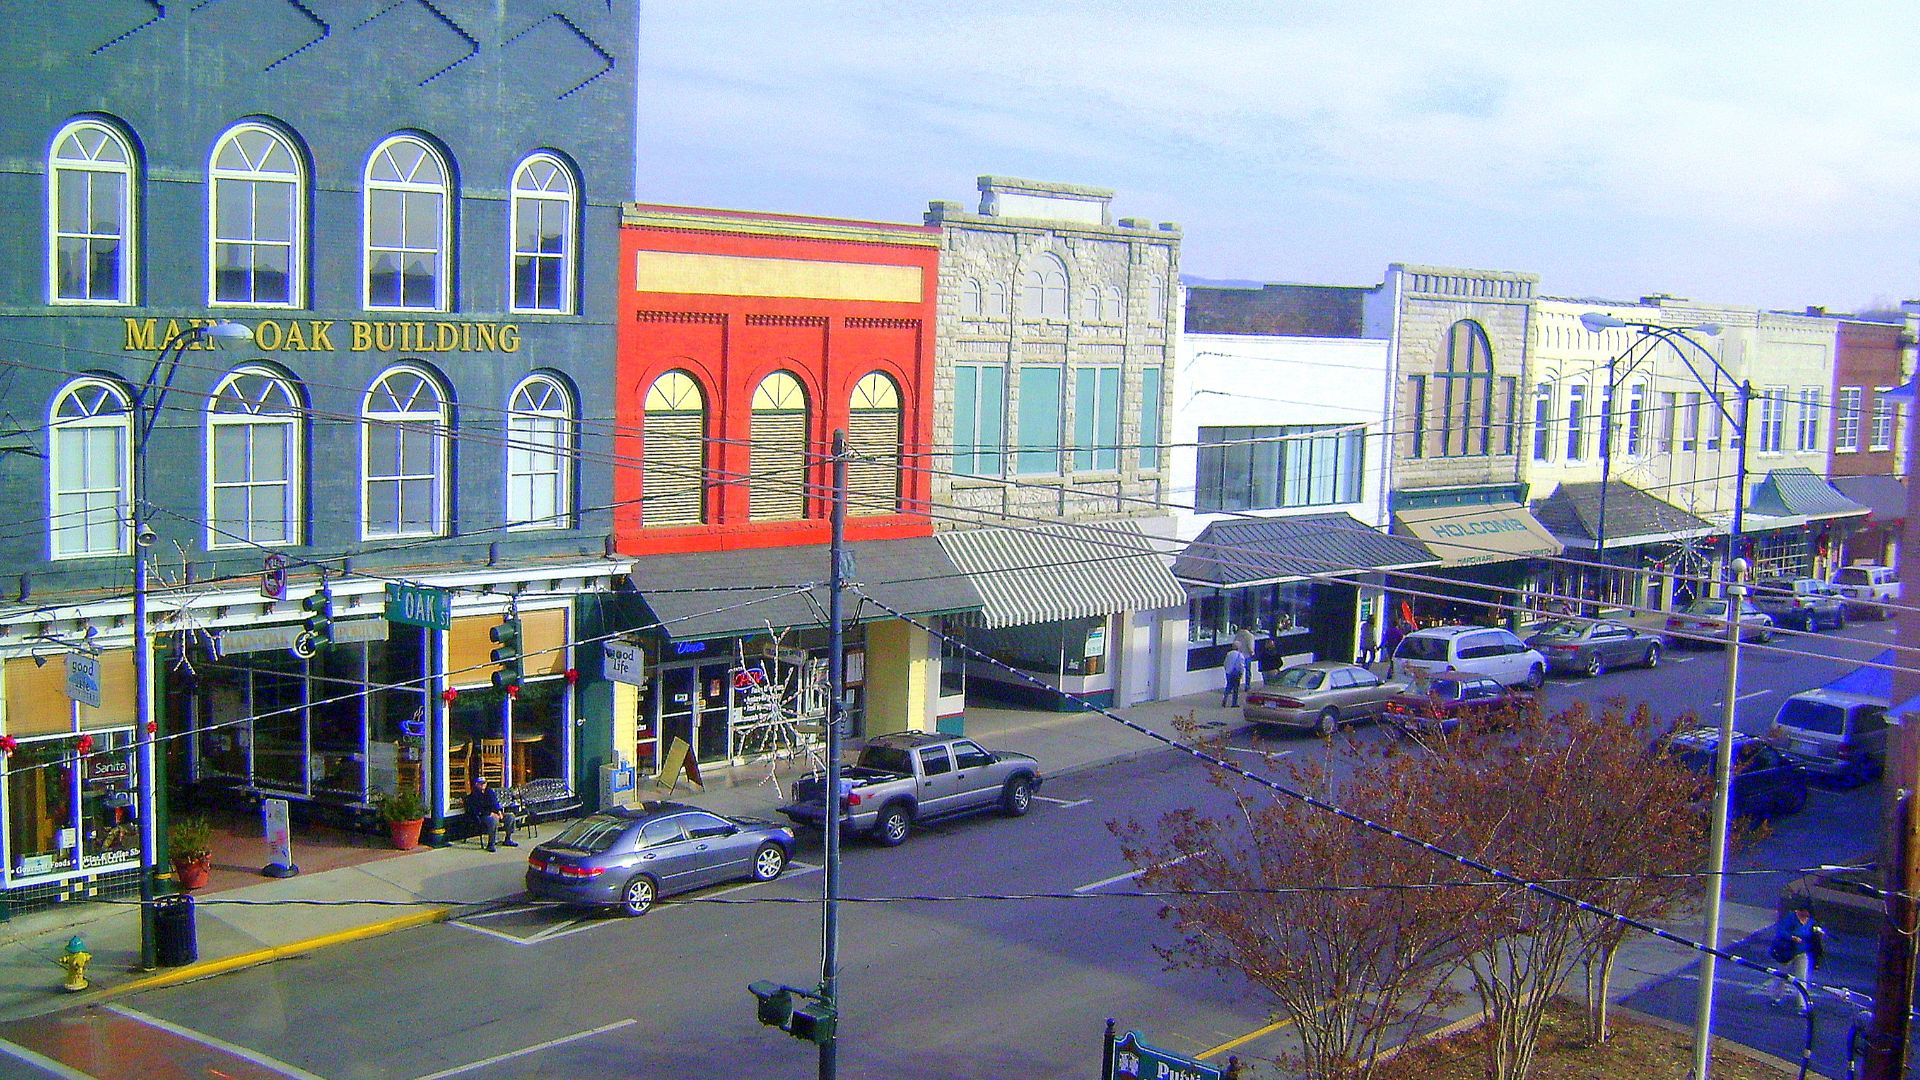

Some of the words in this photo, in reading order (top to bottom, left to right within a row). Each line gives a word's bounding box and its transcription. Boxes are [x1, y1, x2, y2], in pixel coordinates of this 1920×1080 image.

[255, 319, 335, 351] OAK
[351, 321, 522, 353] BUILDING
[1430, 518, 1528, 539] HOLCOMB
[405, 592, 435, 622] OAK
[72, 661, 94, 676] good
[95, 762, 127, 774] Sanita
